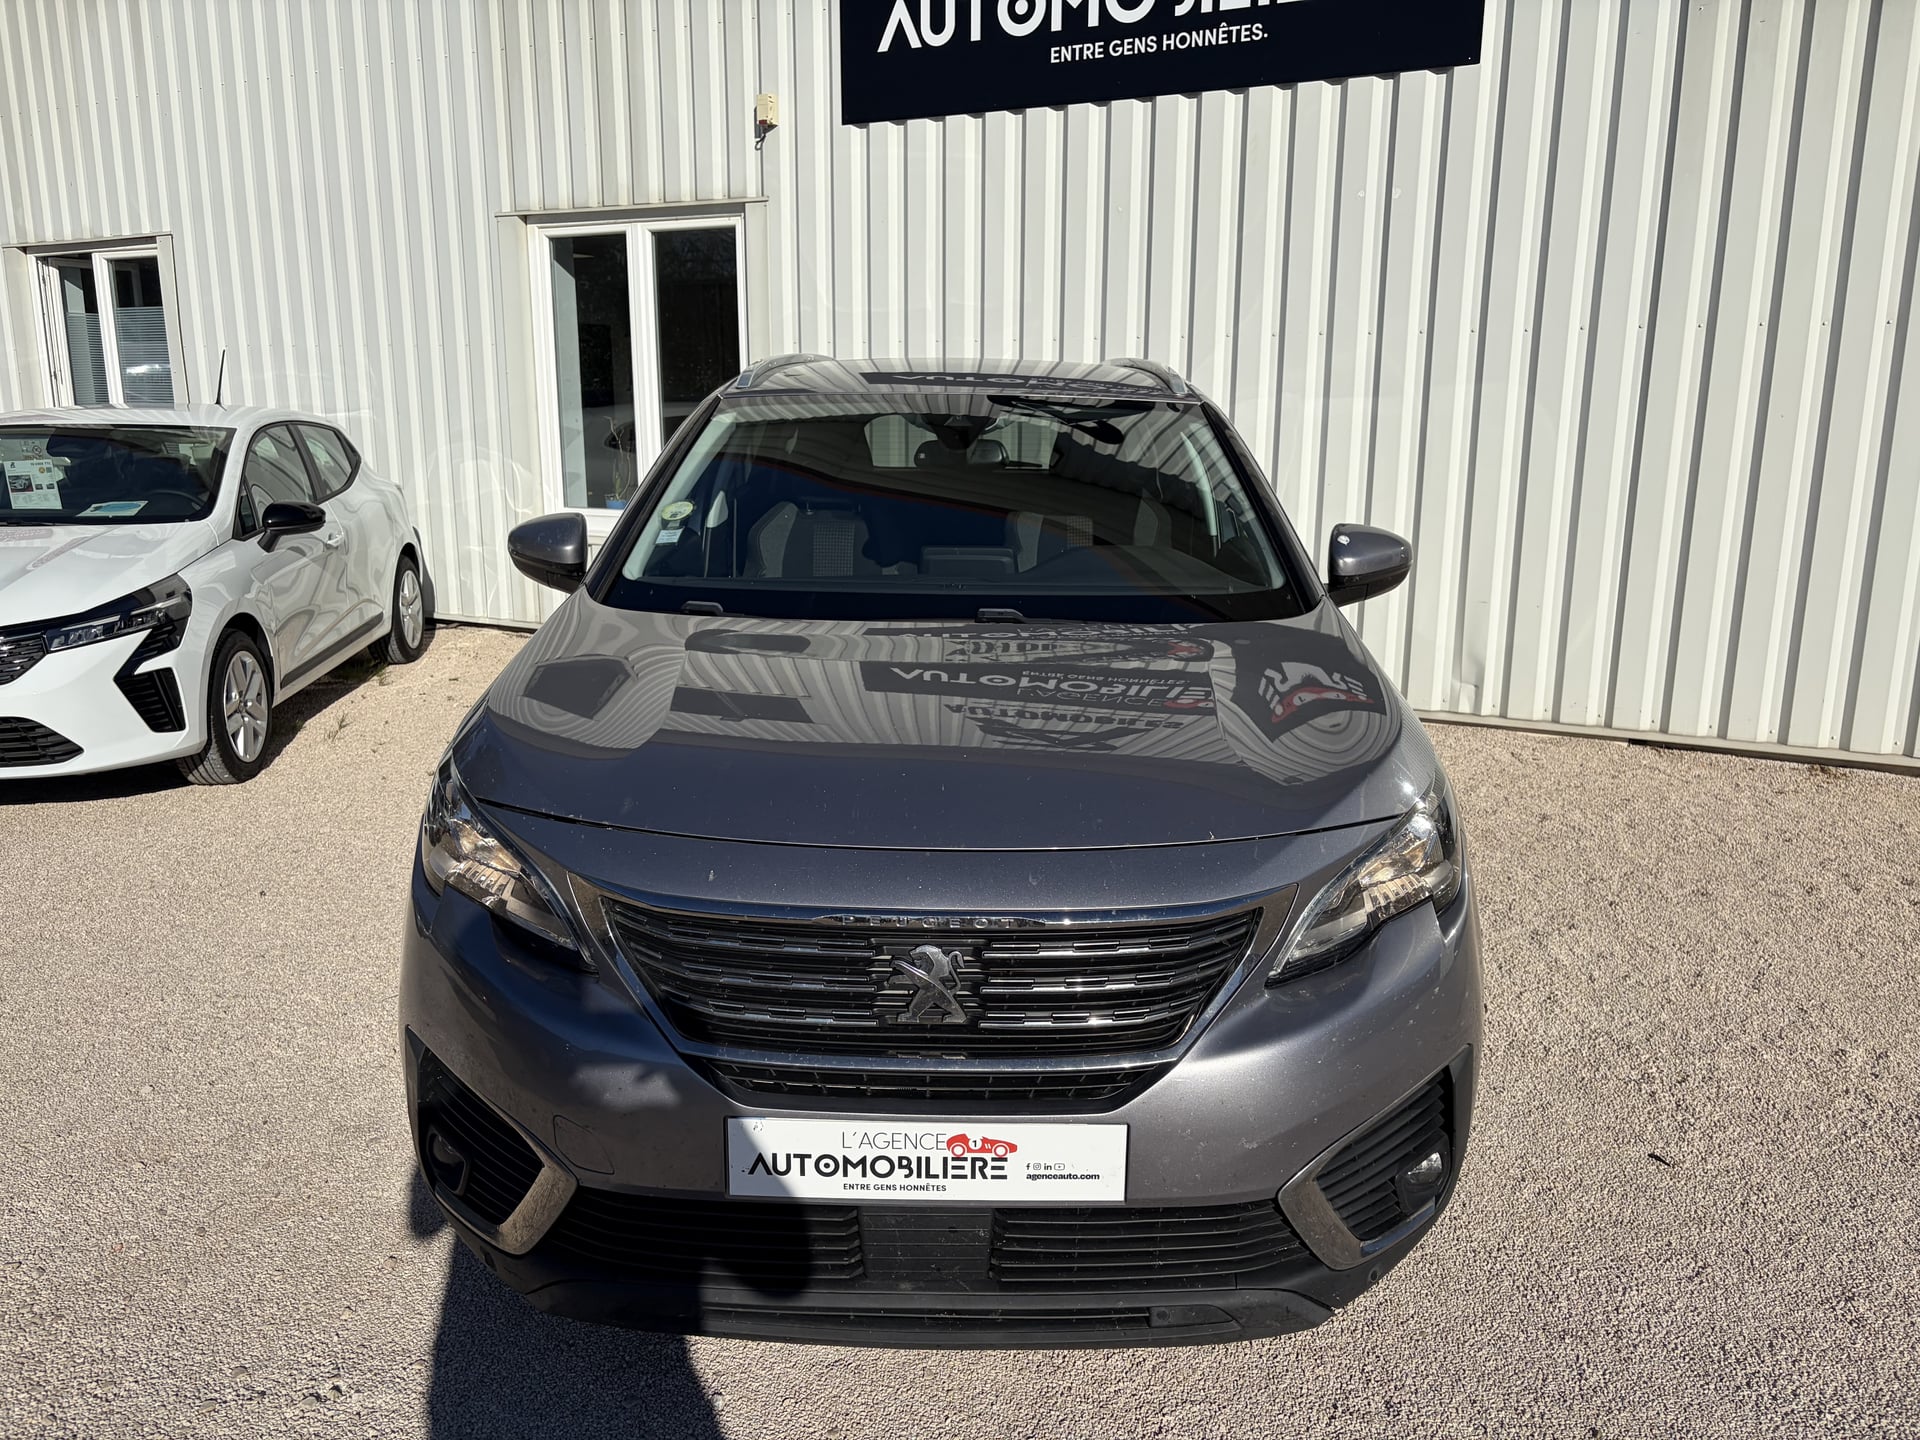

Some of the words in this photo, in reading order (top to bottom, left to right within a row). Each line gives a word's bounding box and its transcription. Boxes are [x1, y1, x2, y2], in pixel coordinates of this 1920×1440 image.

[1050, 42, 1105, 63] ENTRE
[1108, 36, 1157, 57] GENS
[1162, 22, 1268, 51] HONNÊTES.
[842, 915, 1014, 928] PEUGEOT
[842, 1131, 947, 1151] L'AGENCE
[1025, 1173, 1100, 1181] agenceauto.com
[873, 1183, 897, 1191] GENS
[899, 1182, 947, 1192] HONNÊTES
